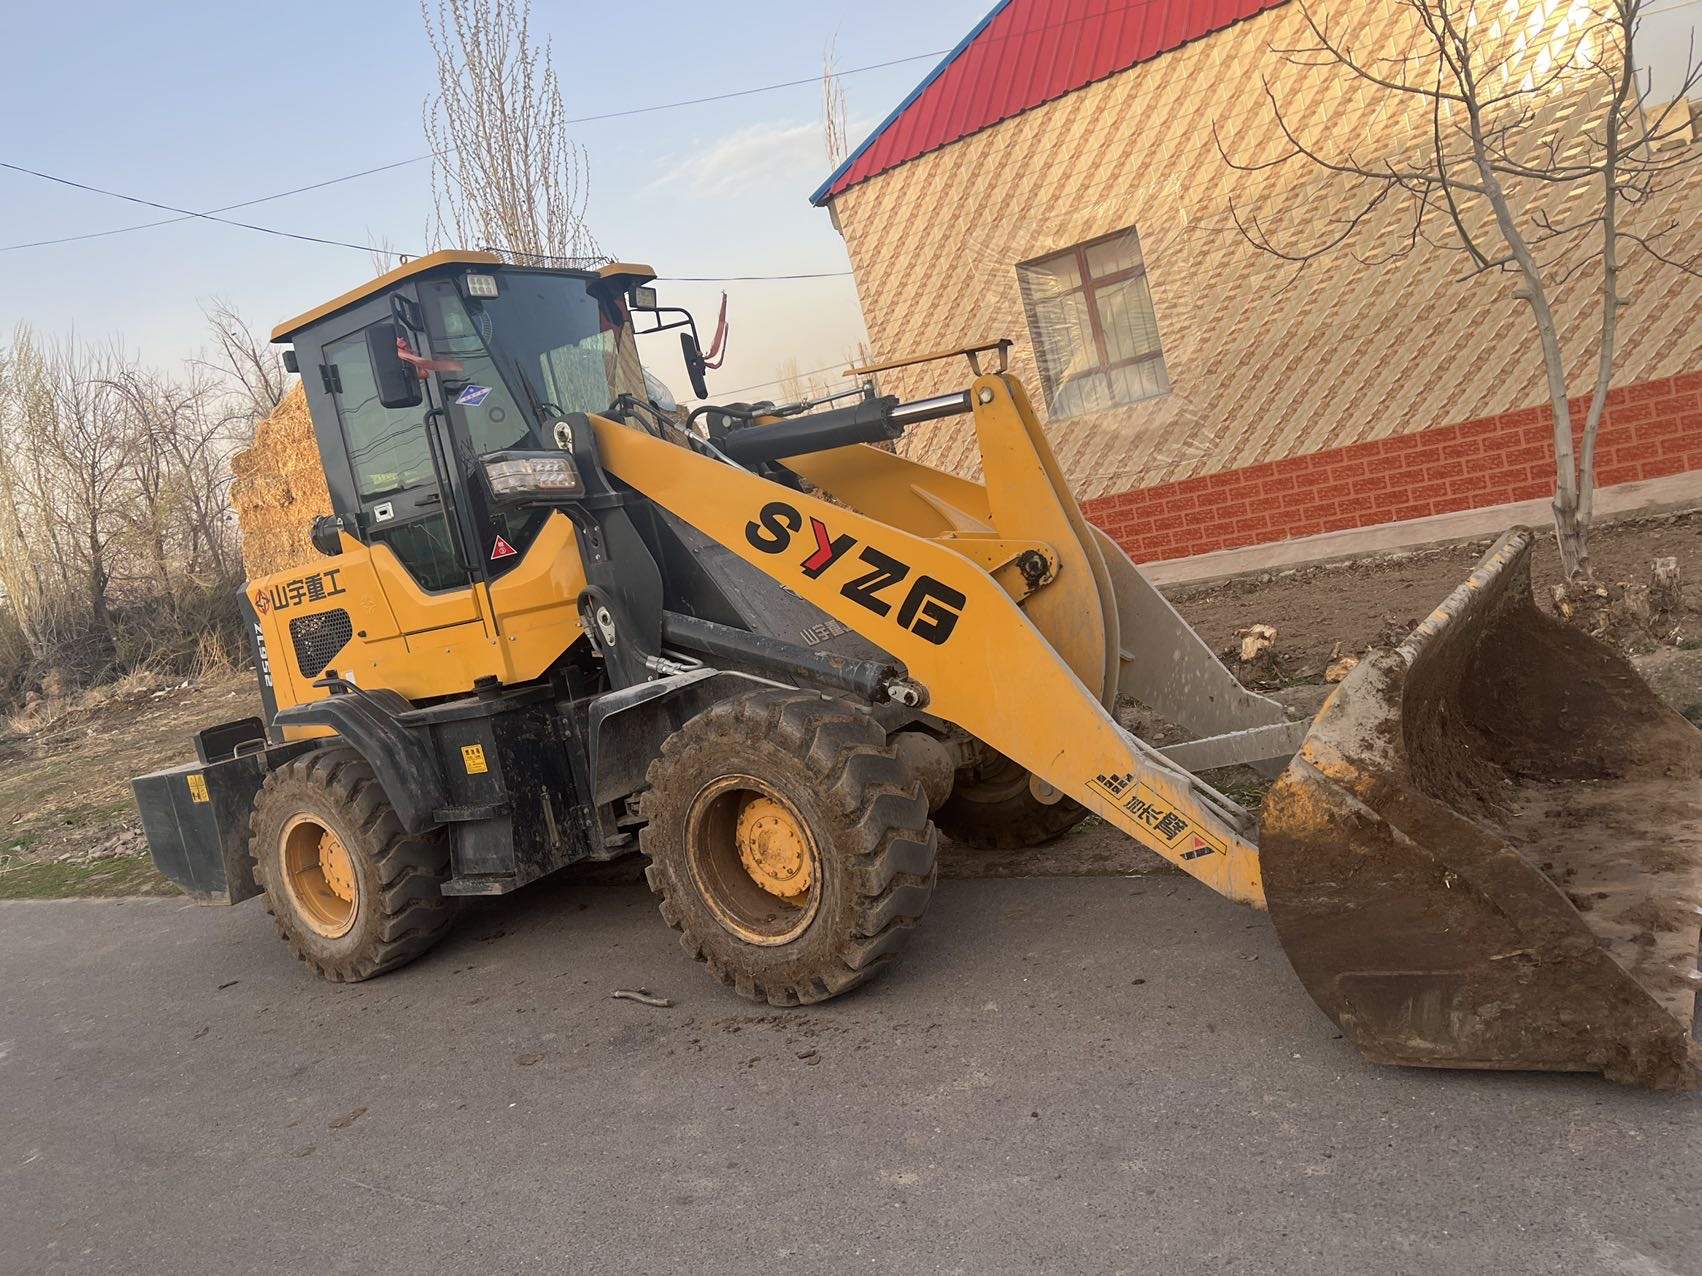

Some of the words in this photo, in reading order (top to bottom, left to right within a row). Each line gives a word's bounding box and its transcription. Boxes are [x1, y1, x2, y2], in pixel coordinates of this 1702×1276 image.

[270, 568, 346, 610] 山宇重工
[745, 501, 967, 645] SYZG
[800, 619, 849, 646] 山宇重
[1123, 795, 1188, 840] 加长臂
